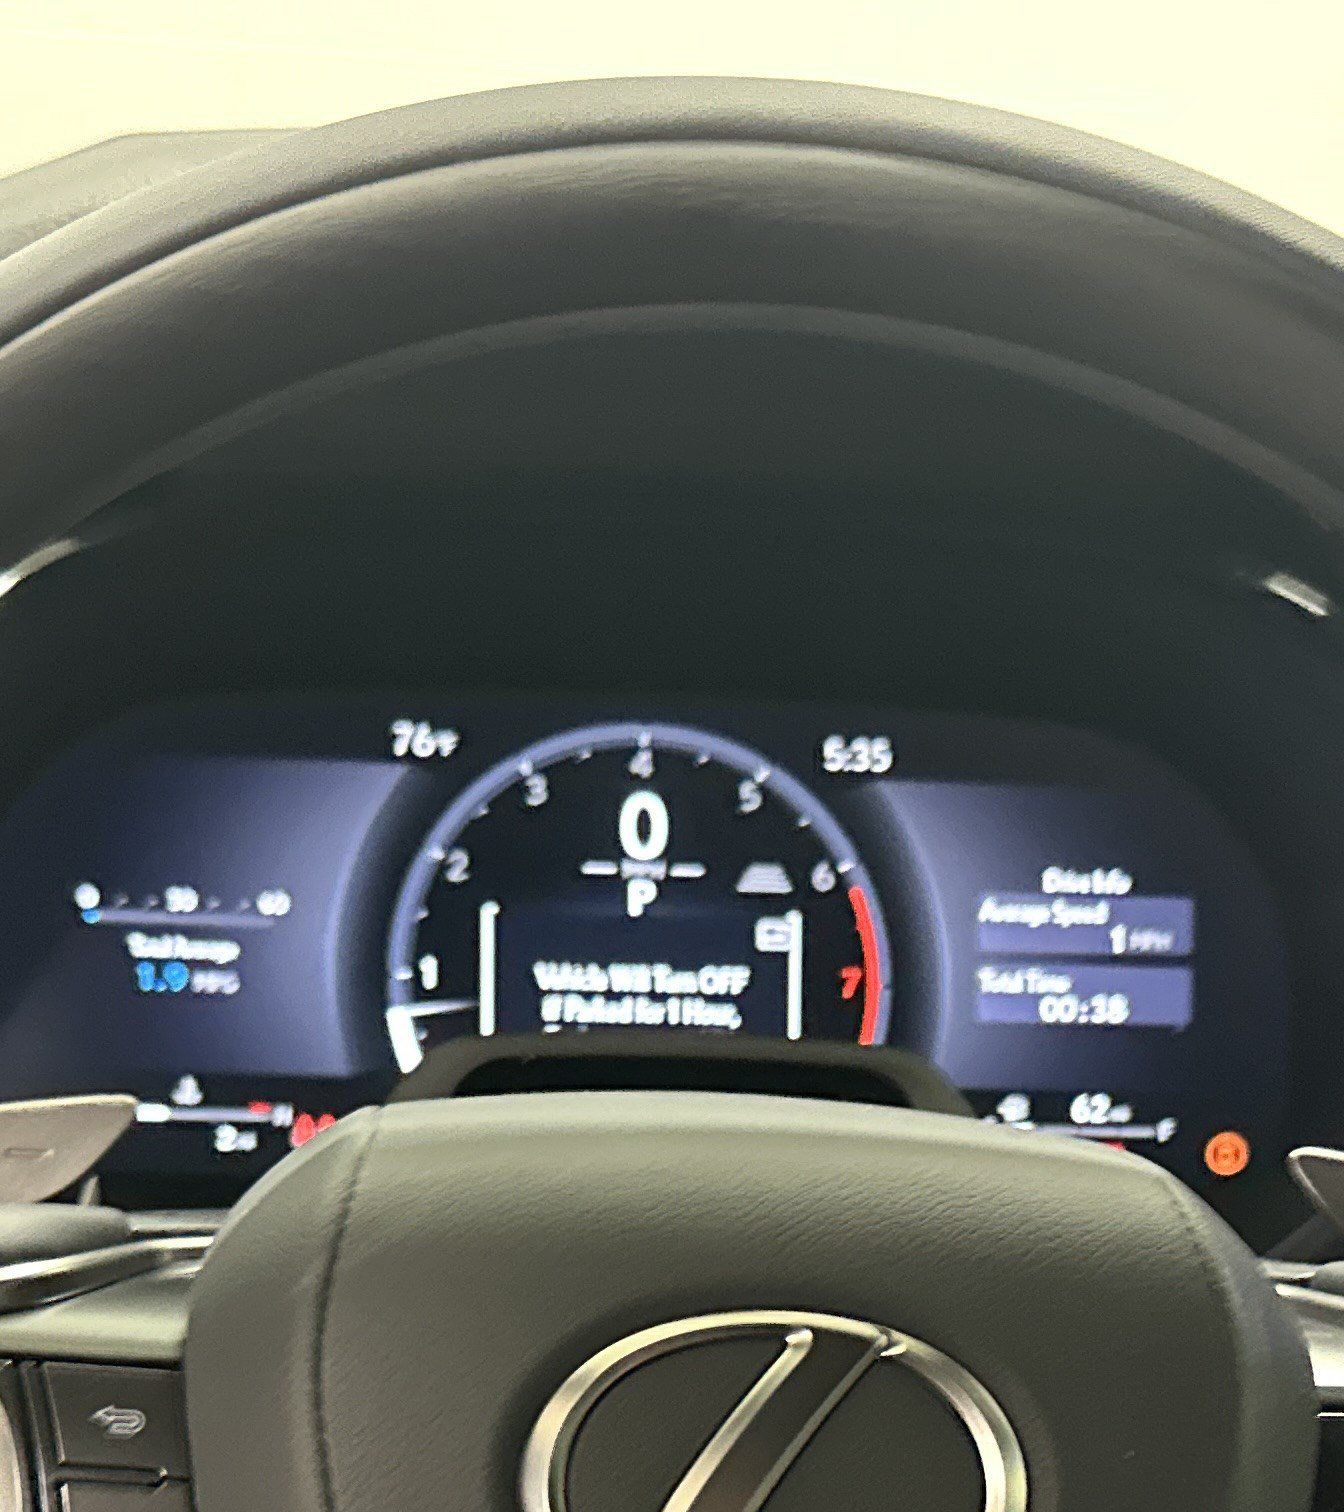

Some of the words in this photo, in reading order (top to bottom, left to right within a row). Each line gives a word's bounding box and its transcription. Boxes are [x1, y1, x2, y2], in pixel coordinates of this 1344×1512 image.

[629, 749, 655, 778] 4
[822, 734, 894, 773] 5:35
[525, 773, 549, 807] 3
[737, 779, 763, 814] 5
[619, 790, 669, 861] 0
[445, 850, 470, 883] 2
[811, 861, 836, 892] 6
[627, 879, 658, 917] P
[979, 897, 1052, 928] Average
[1052, 899, 1110, 928] Speed
[1110, 924, 1127, 954] 1
[419, 954, 439, 990] 1
[533, 960, 609, 991] Vehicle
[609, 963, 653, 993] Will
[653, 963, 698, 995] Turn
[698, 965, 751, 995] OFF
[839, 965, 863, 1000] 7
[978, 967, 1024, 994] Total
[1025, 968, 1073, 994] Time
[563, 993, 633, 1024] Parked
[1069, 1092, 1112, 1124] 62
